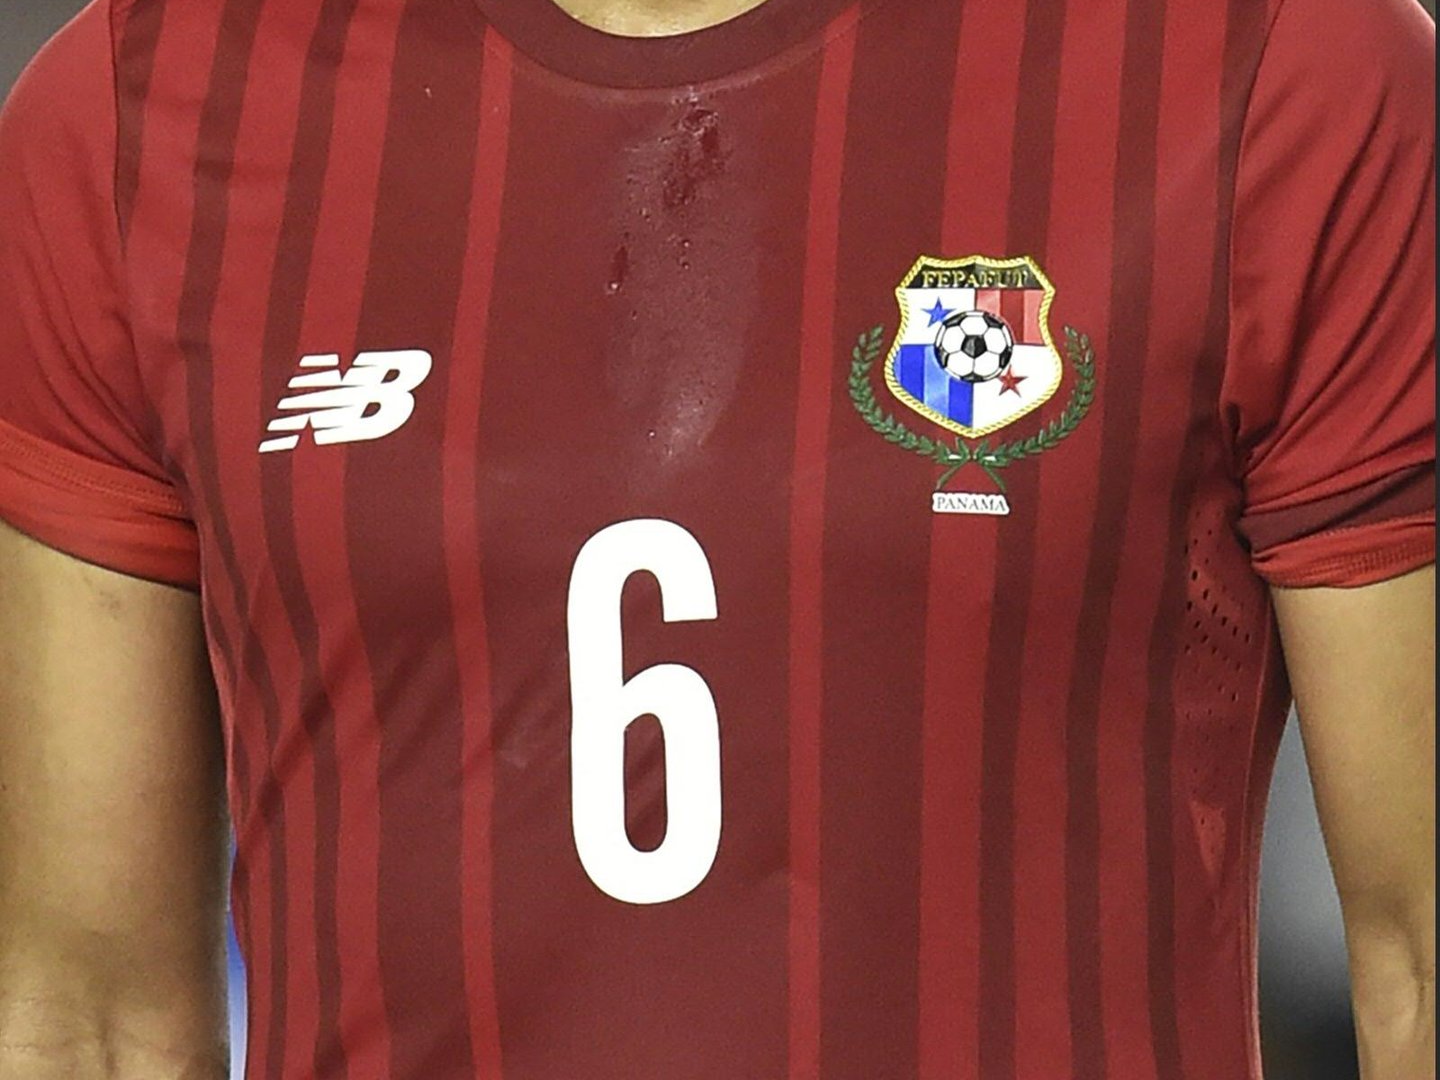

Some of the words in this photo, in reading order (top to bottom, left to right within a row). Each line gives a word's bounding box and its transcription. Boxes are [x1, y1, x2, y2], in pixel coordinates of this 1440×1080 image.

[921, 270, 1028, 288] FEPAFUT
[936, 496, 1006, 512] PANAMA
[566, 517, 722, 905] 6
